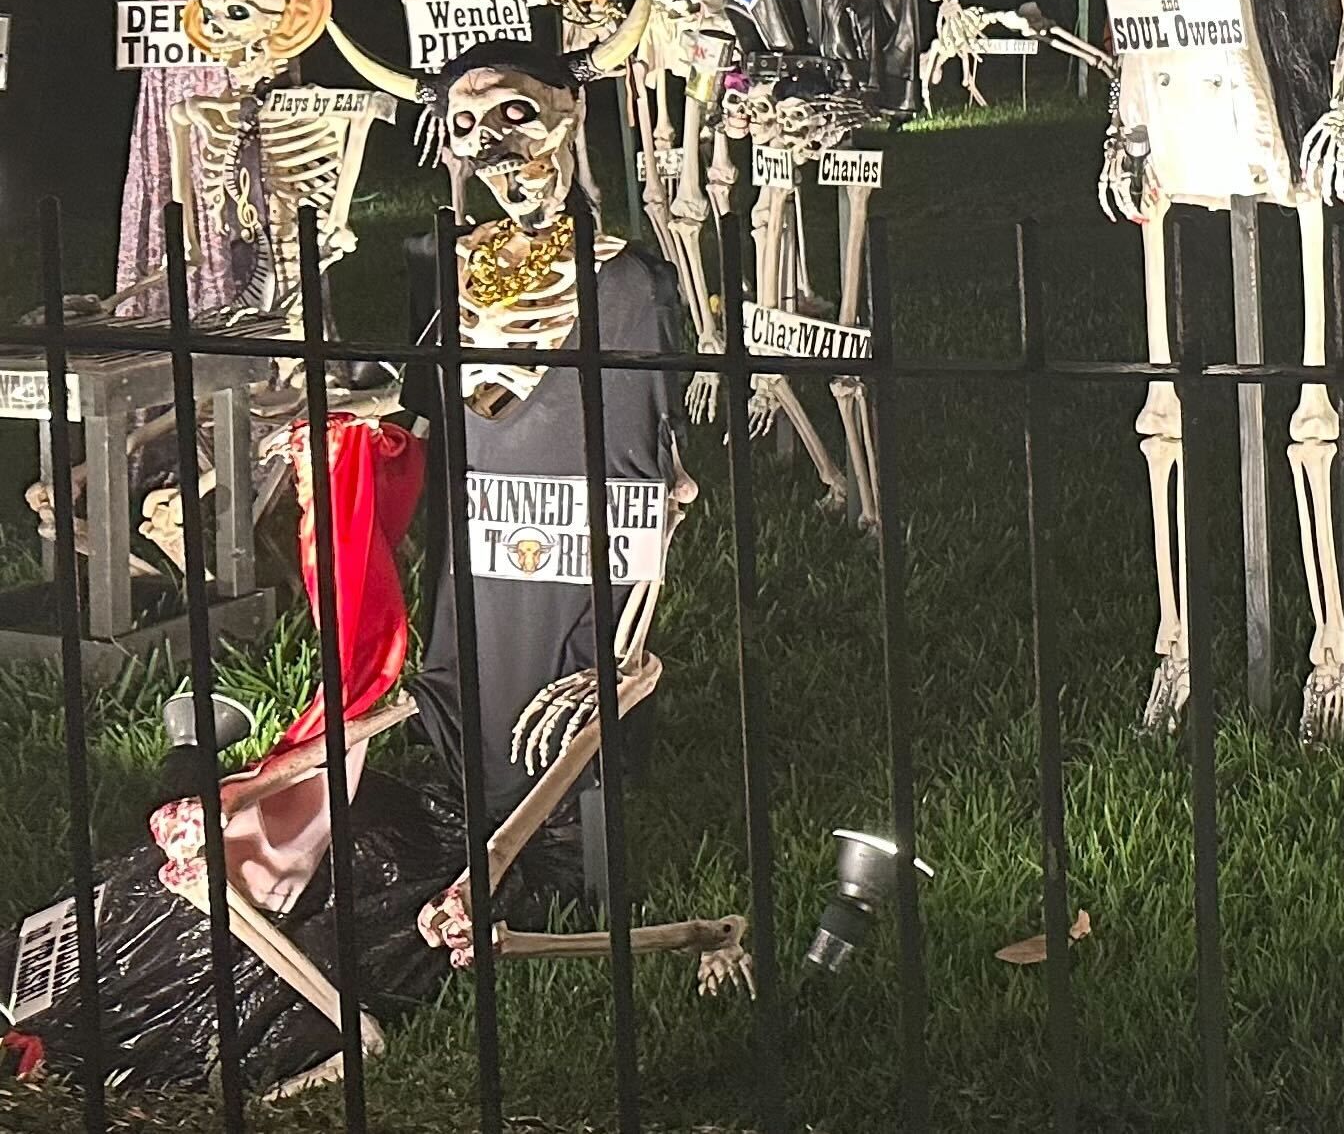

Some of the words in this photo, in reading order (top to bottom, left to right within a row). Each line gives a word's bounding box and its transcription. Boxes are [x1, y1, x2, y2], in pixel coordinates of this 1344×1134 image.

[1113, 16, 1169, 50] SOUL
[1174, 14, 1244, 47] Owens
[271, 92, 311, 116] Plays
[313, 92, 331, 116] by
[334, 92, 366, 112] EAR
[755, 148, 790, 185] Cyril
[821, 151, 880, 184] Charles
[597, 484, 659, 529] NEE
